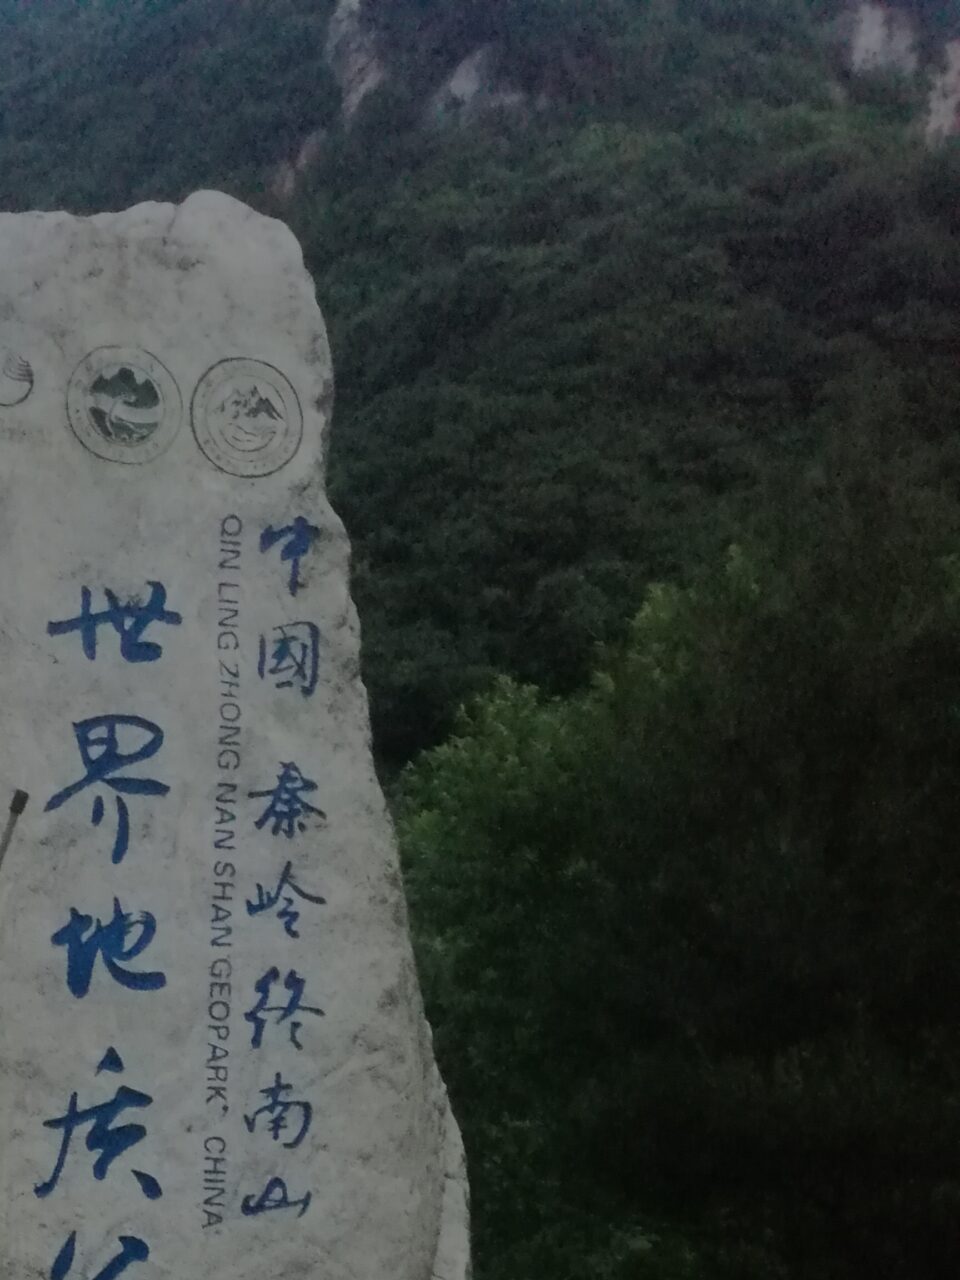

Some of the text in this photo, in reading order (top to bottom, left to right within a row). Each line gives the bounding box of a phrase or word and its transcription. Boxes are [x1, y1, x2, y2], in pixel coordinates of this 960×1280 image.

[217, 513, 242, 571] QIN
[216, 582, 239, 651] LING
[215, 659, 241, 771] ZHONG
[213, 781, 238, 851] NAN
[209, 860, 236, 947] SHAN
[201, 1136, 226, 1231] CHINA
